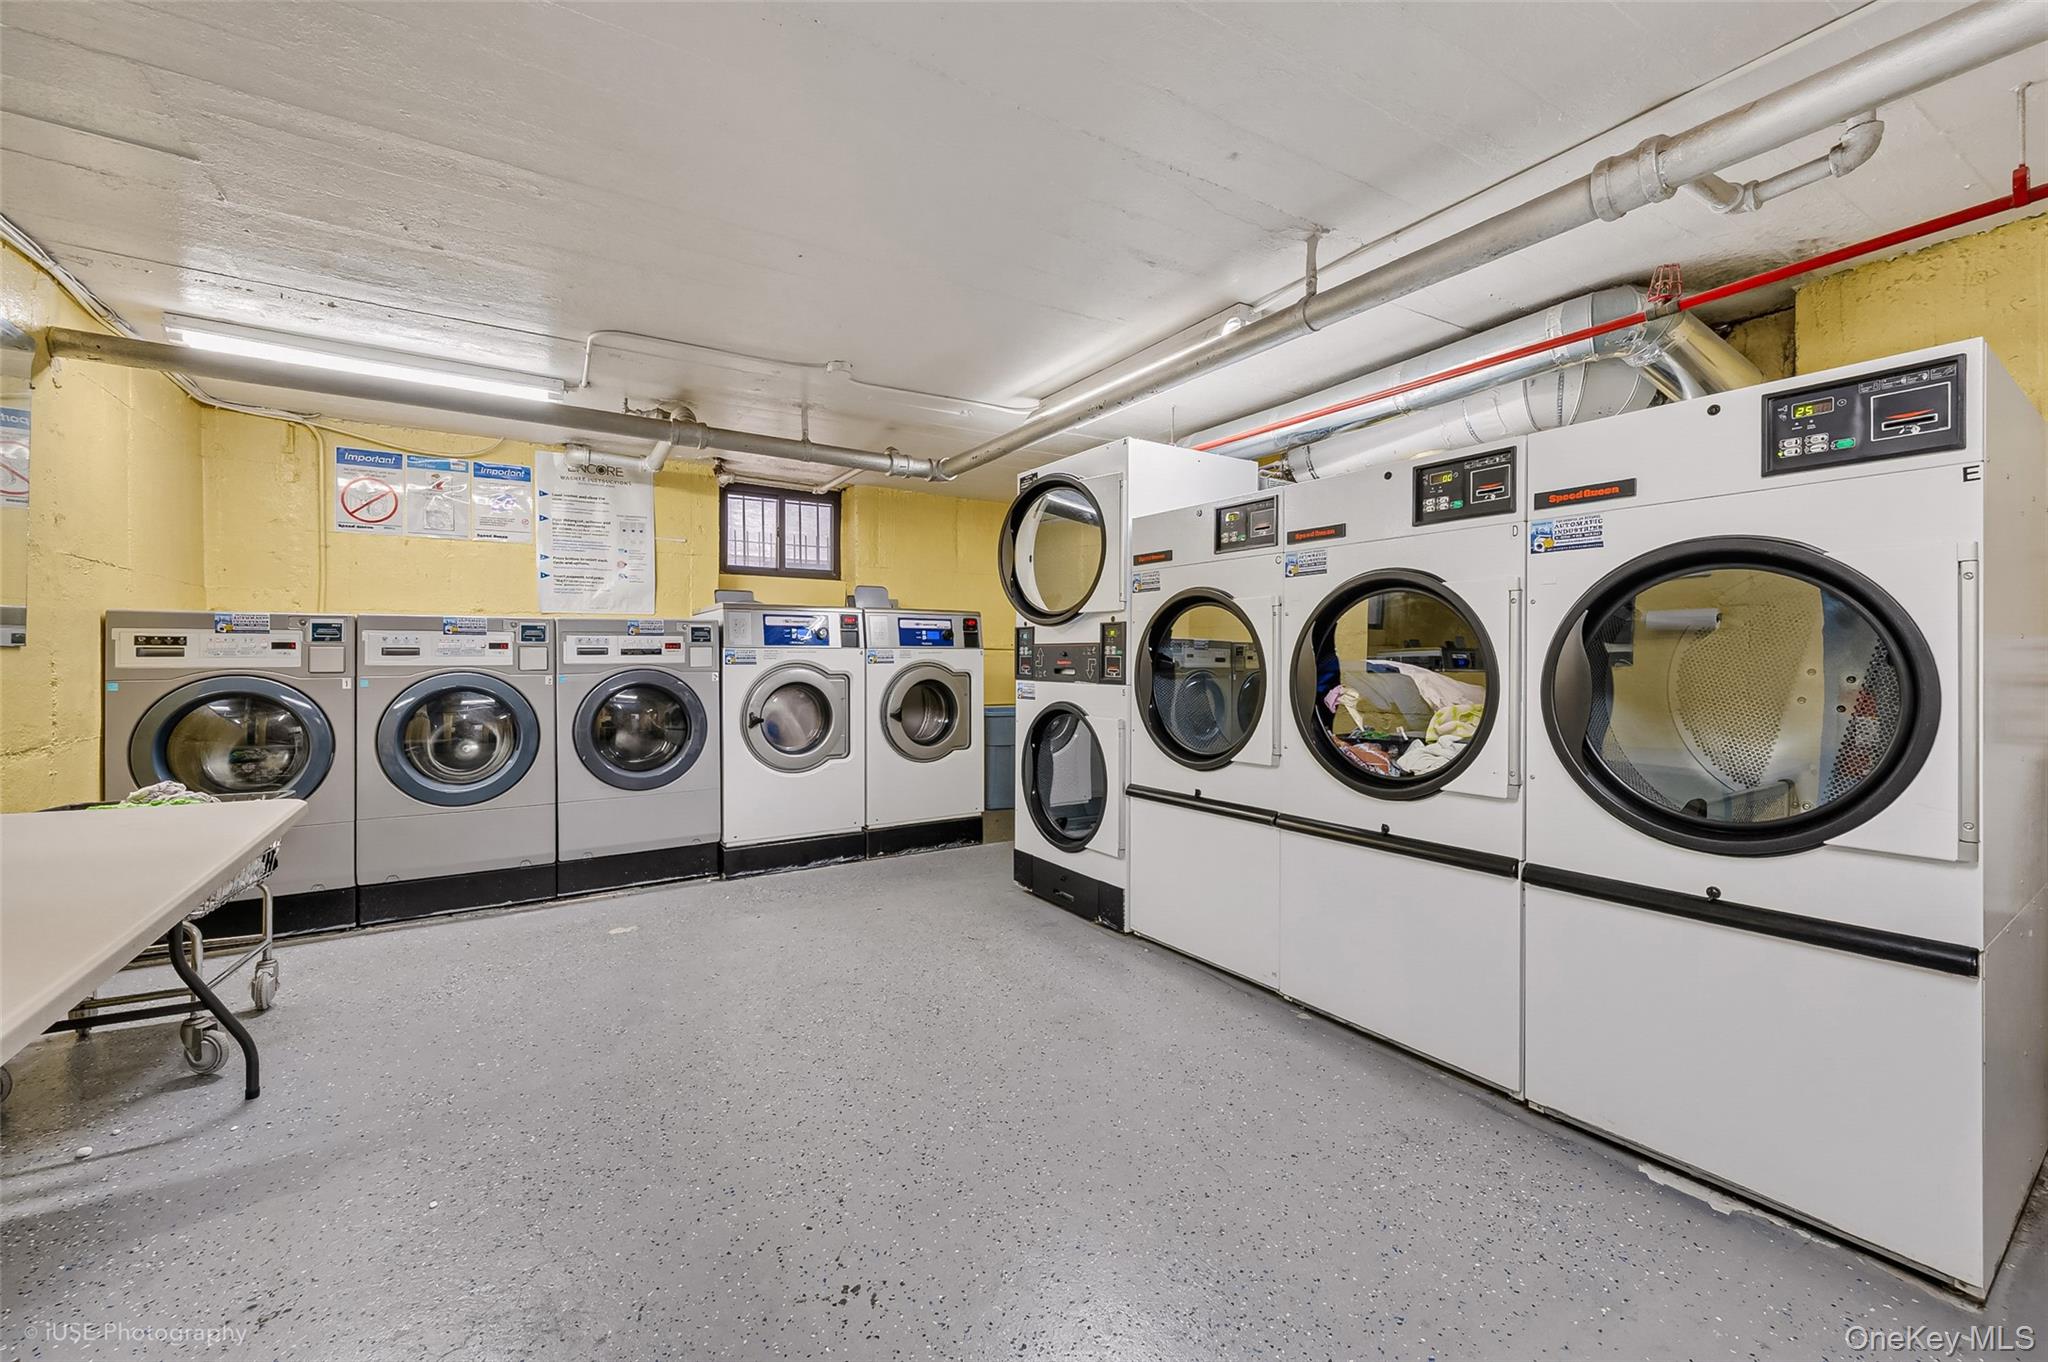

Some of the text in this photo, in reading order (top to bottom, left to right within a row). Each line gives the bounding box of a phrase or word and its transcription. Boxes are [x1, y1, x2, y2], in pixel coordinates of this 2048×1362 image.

[1794, 405, 1813, 419] 25
[344, 452, 396, 465] Important
[480, 466, 526, 479] Important
[1962, 465, 1982, 483] E
[1548, 486, 1620, 504] Speed Queen
[1554, 518, 1604, 530] AUTOMATIC
[1554, 525, 1604, 535] INDUSTRIES
[1512, 525, 1519, 537] D
[1275, 555, 1282, 565] C
